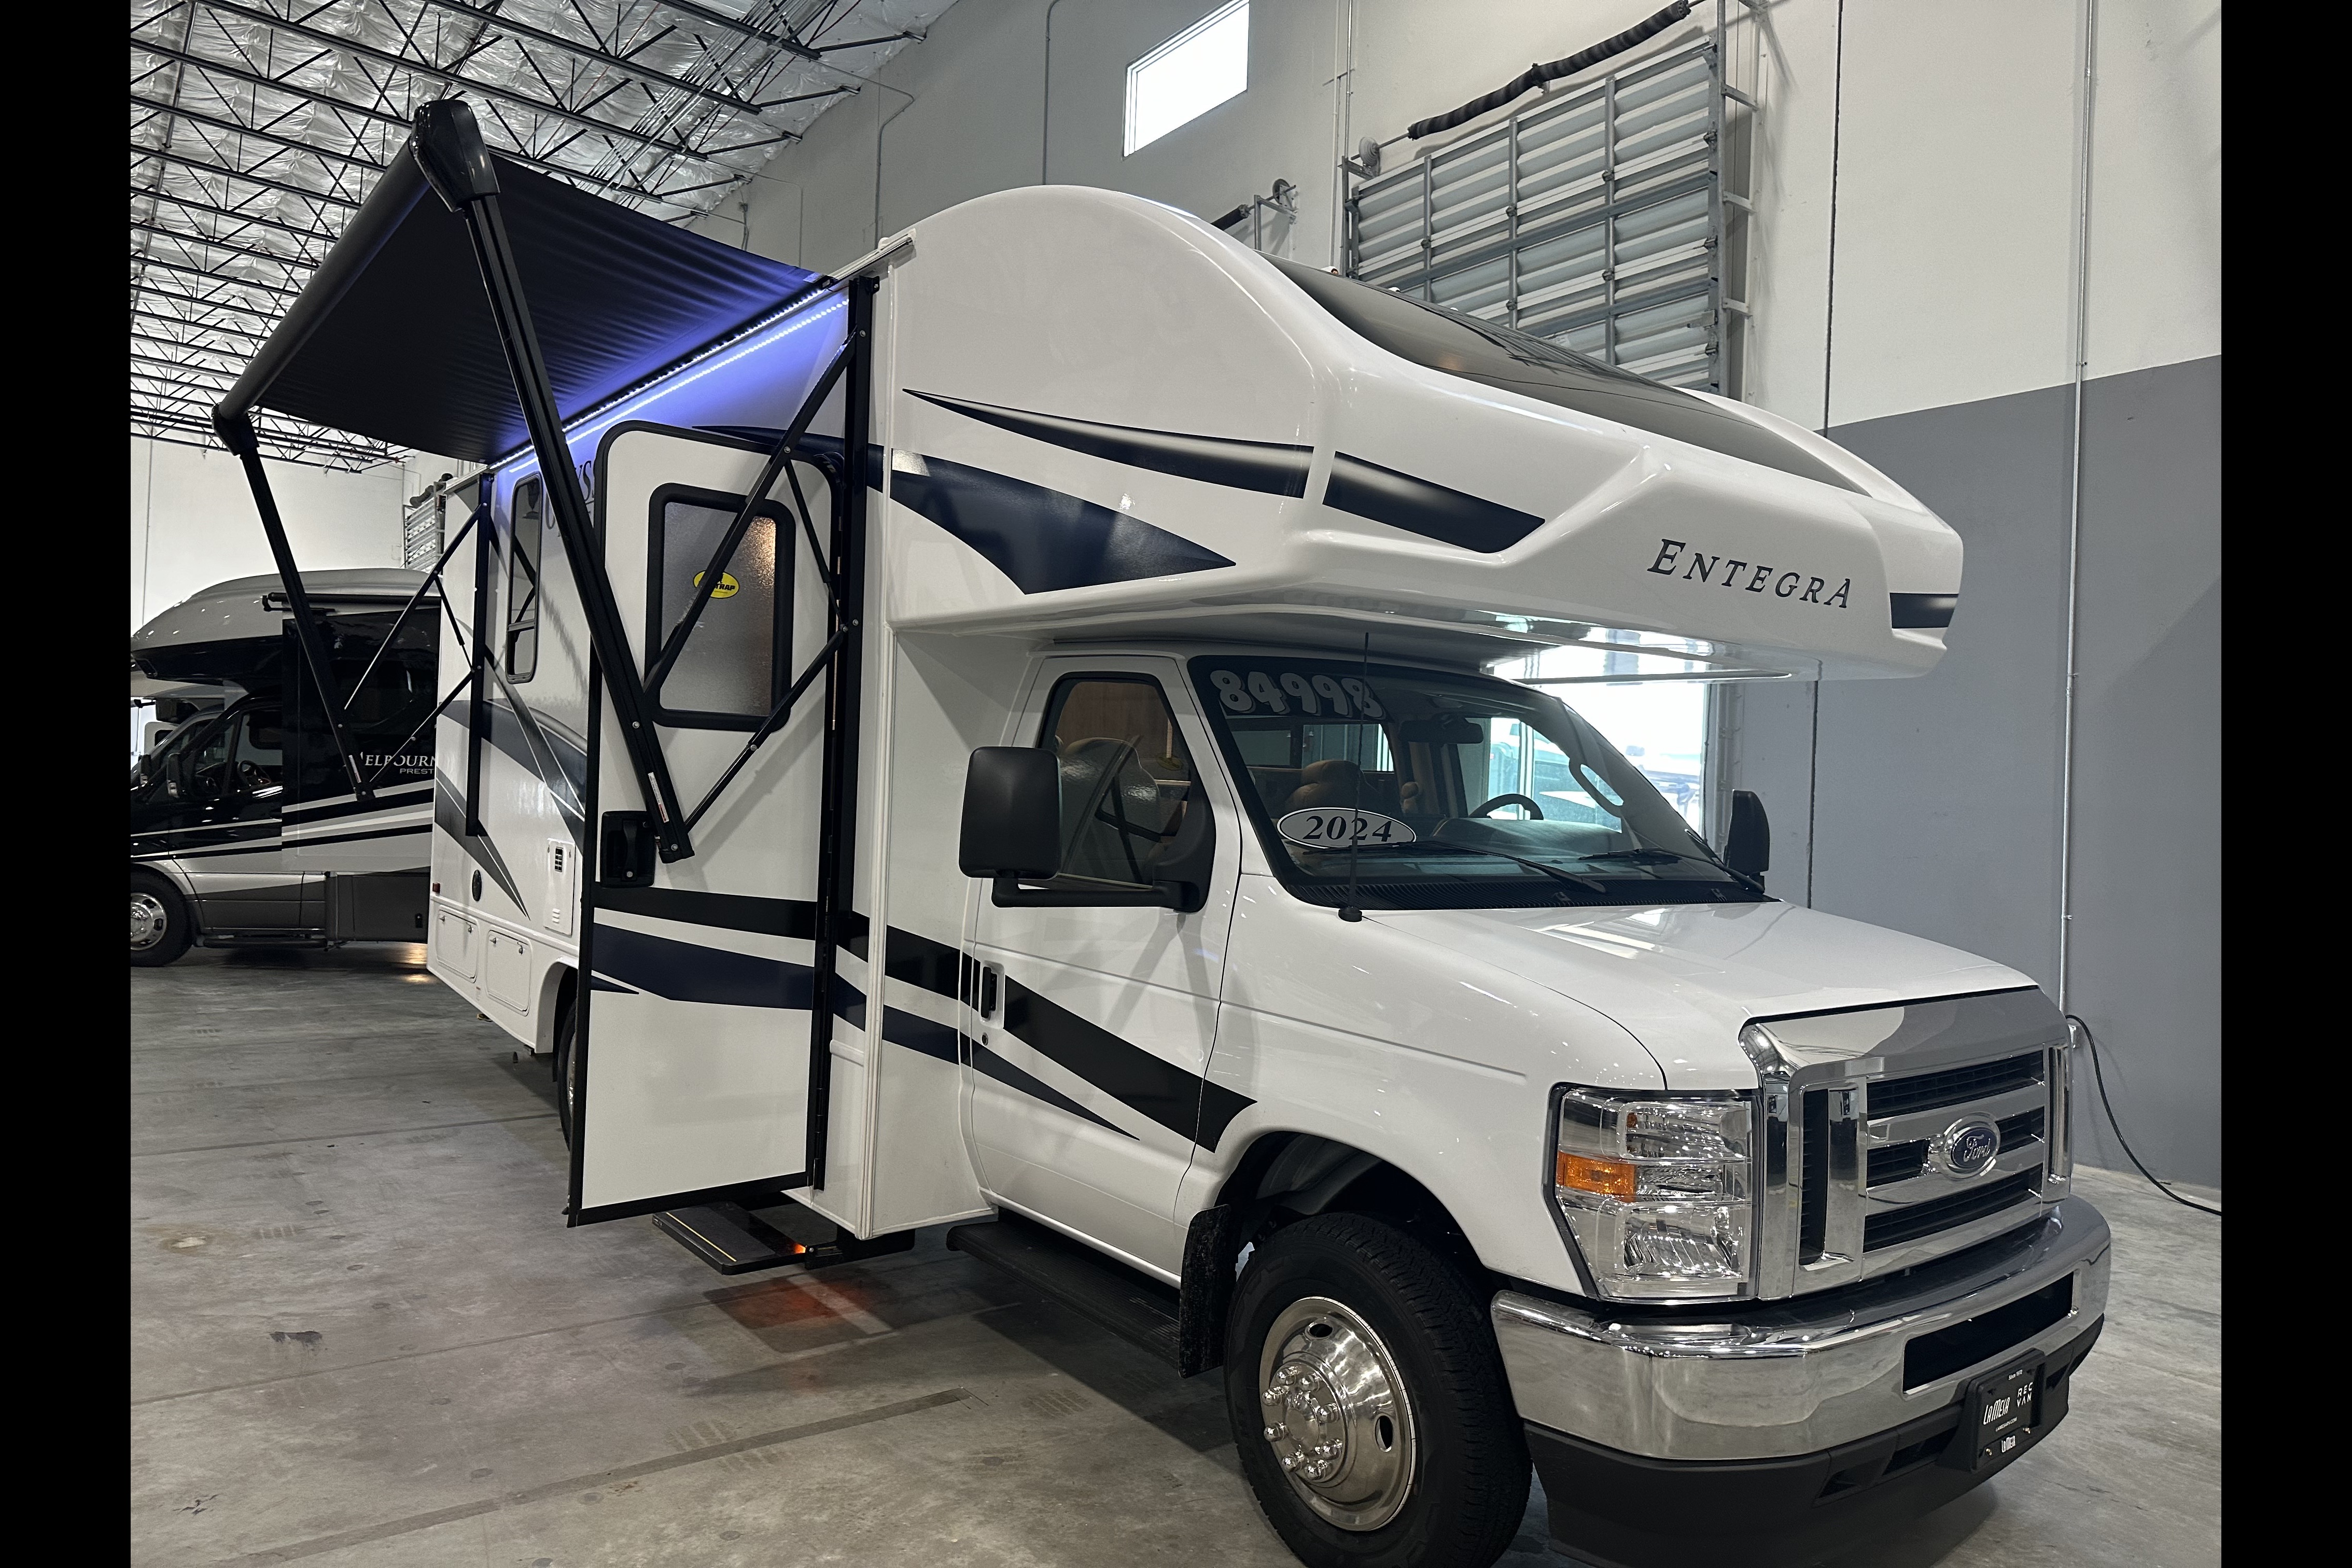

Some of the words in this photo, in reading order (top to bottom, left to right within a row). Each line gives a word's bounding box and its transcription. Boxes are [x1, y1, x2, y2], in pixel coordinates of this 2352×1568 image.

[1647, 538, 1852, 609] ENTEGRA
[1210, 669, 1385, 720] 84998
[1302, 815, 1392, 842] 2024
[1963, 1134, 1991, 1163] Ford
[2017, 1381, 2033, 1397] REC
[2017, 1392, 2032, 1408] VAN
